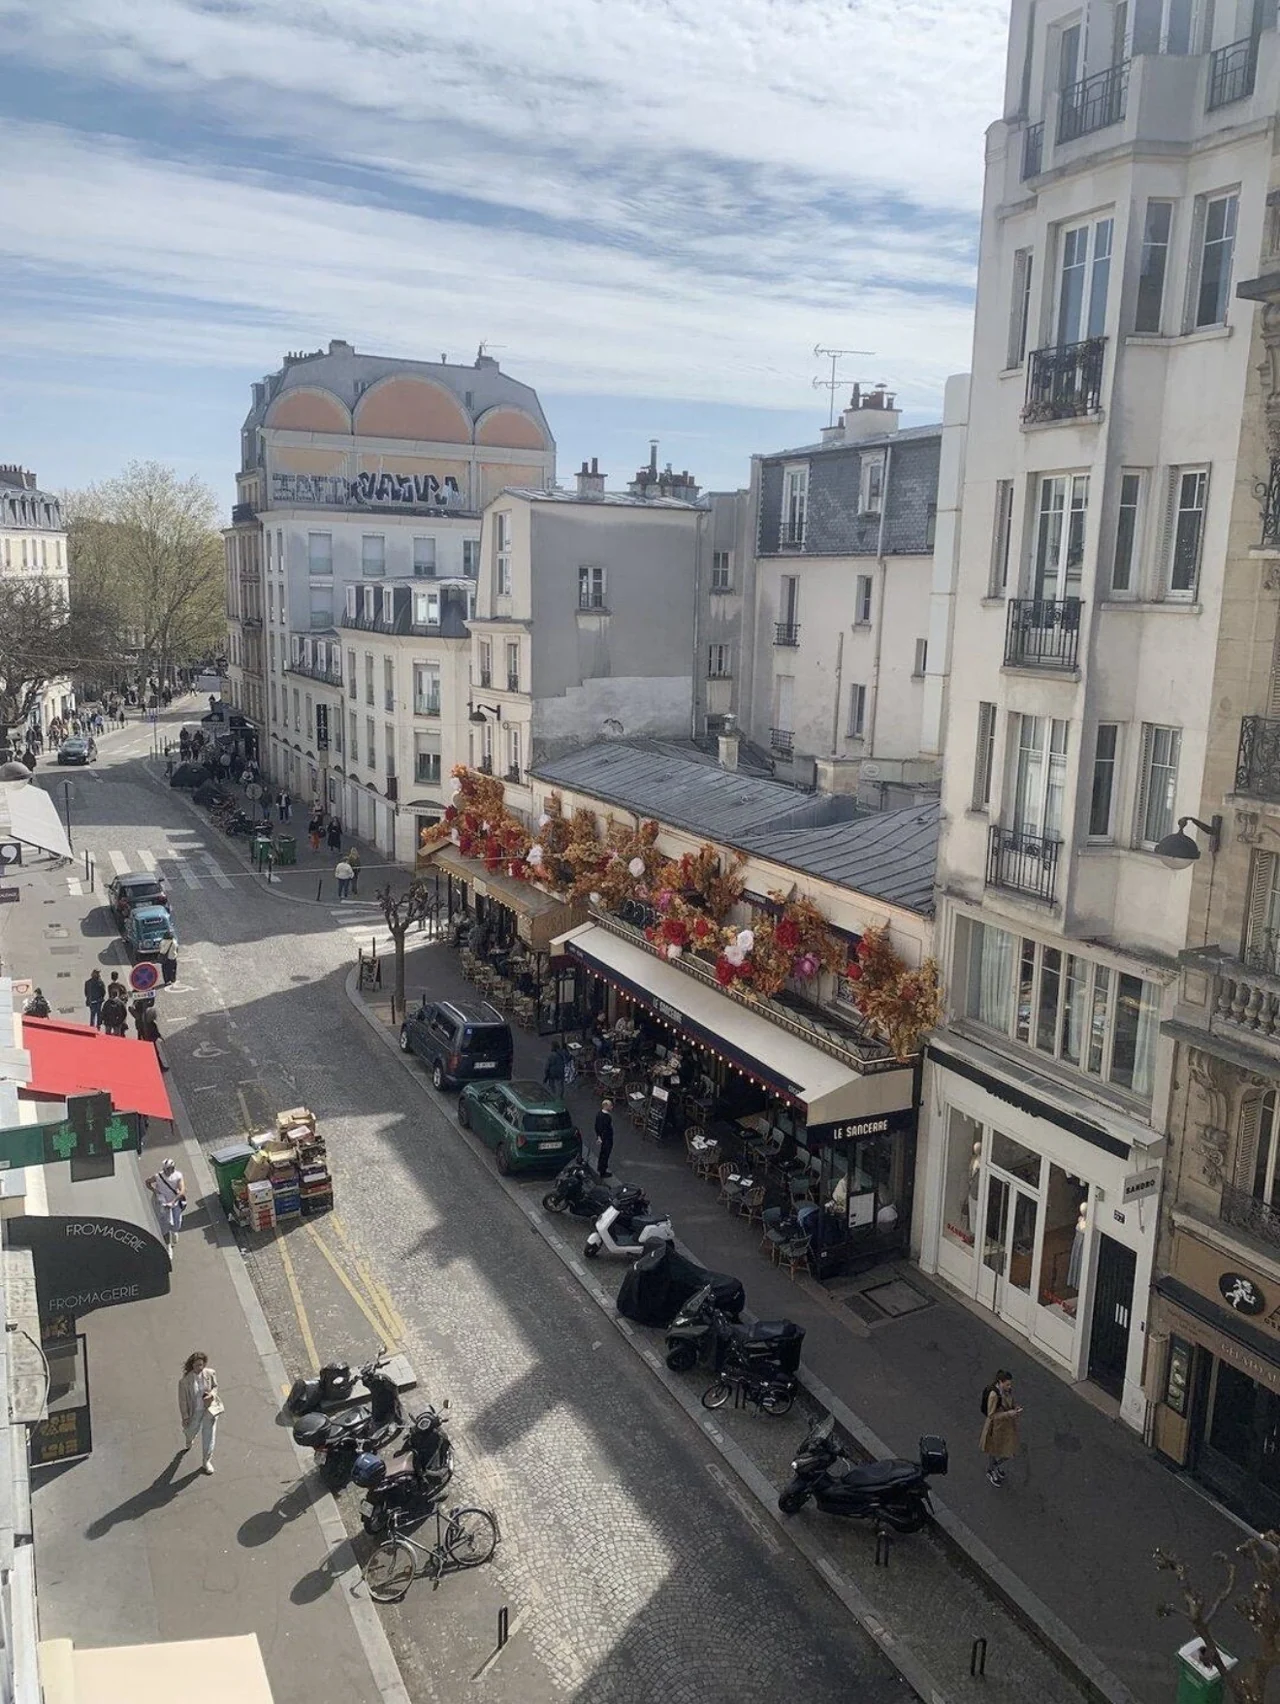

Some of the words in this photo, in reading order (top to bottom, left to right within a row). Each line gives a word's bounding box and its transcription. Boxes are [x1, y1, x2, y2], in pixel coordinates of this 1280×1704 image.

[833, 1127, 842, 1140] LE
[846, 1119, 888, 1138] SANCERRE
[1125, 1178, 1156, 1195] SANDRO
[65, 1222, 147, 1253] FROMAGERIE
[49, 1283, 140, 1312] FROMAGERIE
